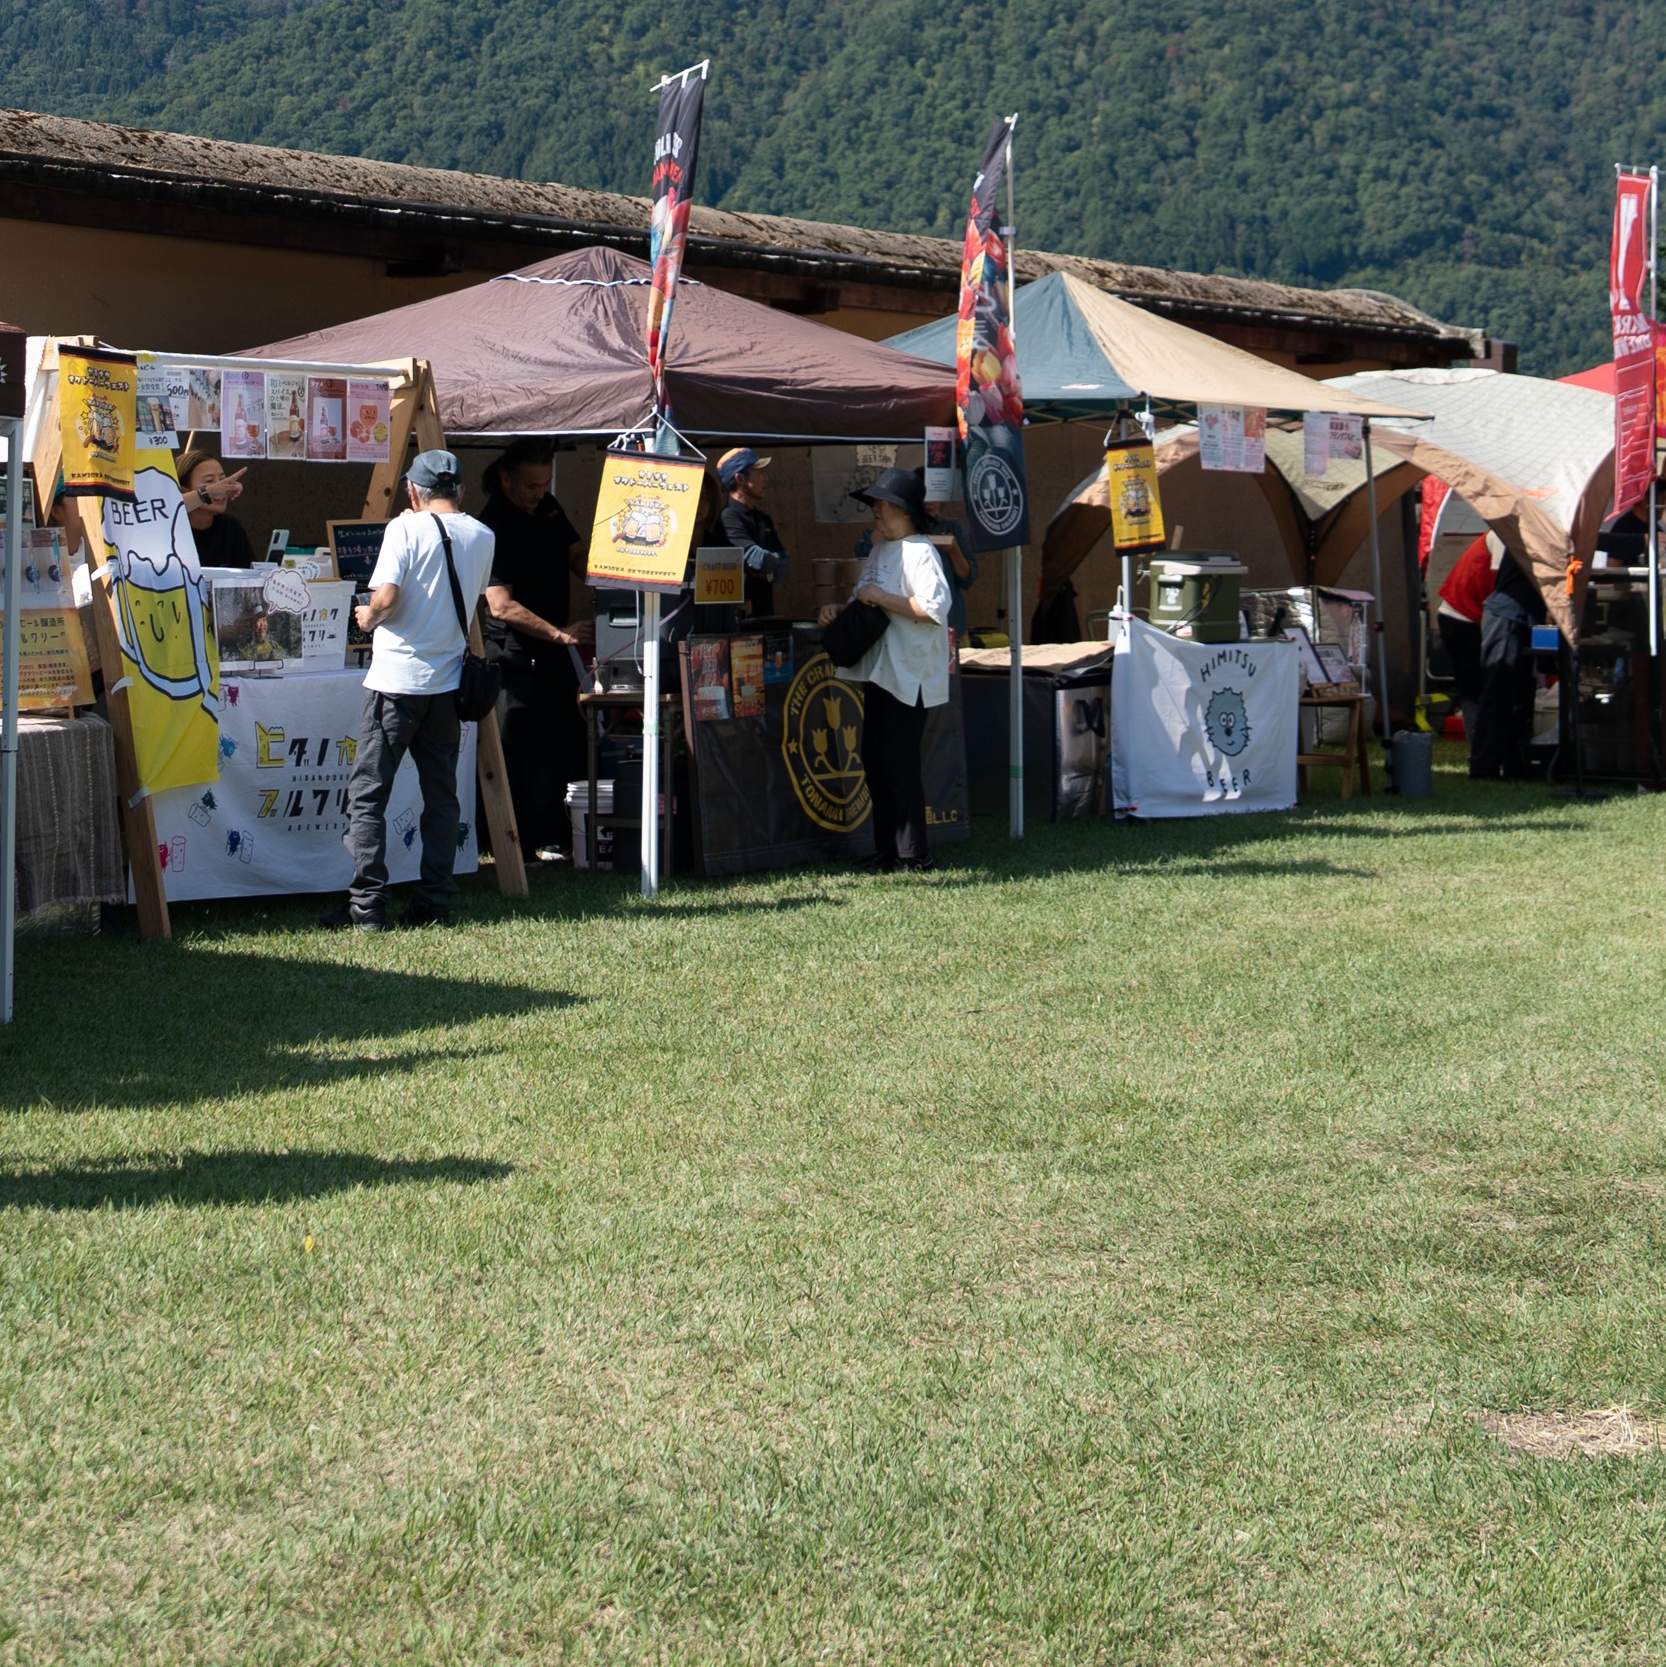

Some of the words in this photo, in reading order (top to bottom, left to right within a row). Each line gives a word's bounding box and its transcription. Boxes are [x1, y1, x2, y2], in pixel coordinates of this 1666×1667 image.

[613, 476, 690, 493] オクトーバーフェスト
[111, 498, 170, 525] BEER
[594, 564, 625, 573] KAMIOKA
[705, 579, 735, 595] ¥700
[1200, 649, 1257, 682] HIMITSU
[790, 683, 808, 716] THE
[808, 663, 837, 685] CRAF
[255, 720, 358, 769] ヒダノオ
[1206, 768, 1252, 793] BEER
[257, 788, 350, 819] ブルワリ
[801, 774, 844, 821] TONAMI
[288, 822, 346, 832] BREWERY
